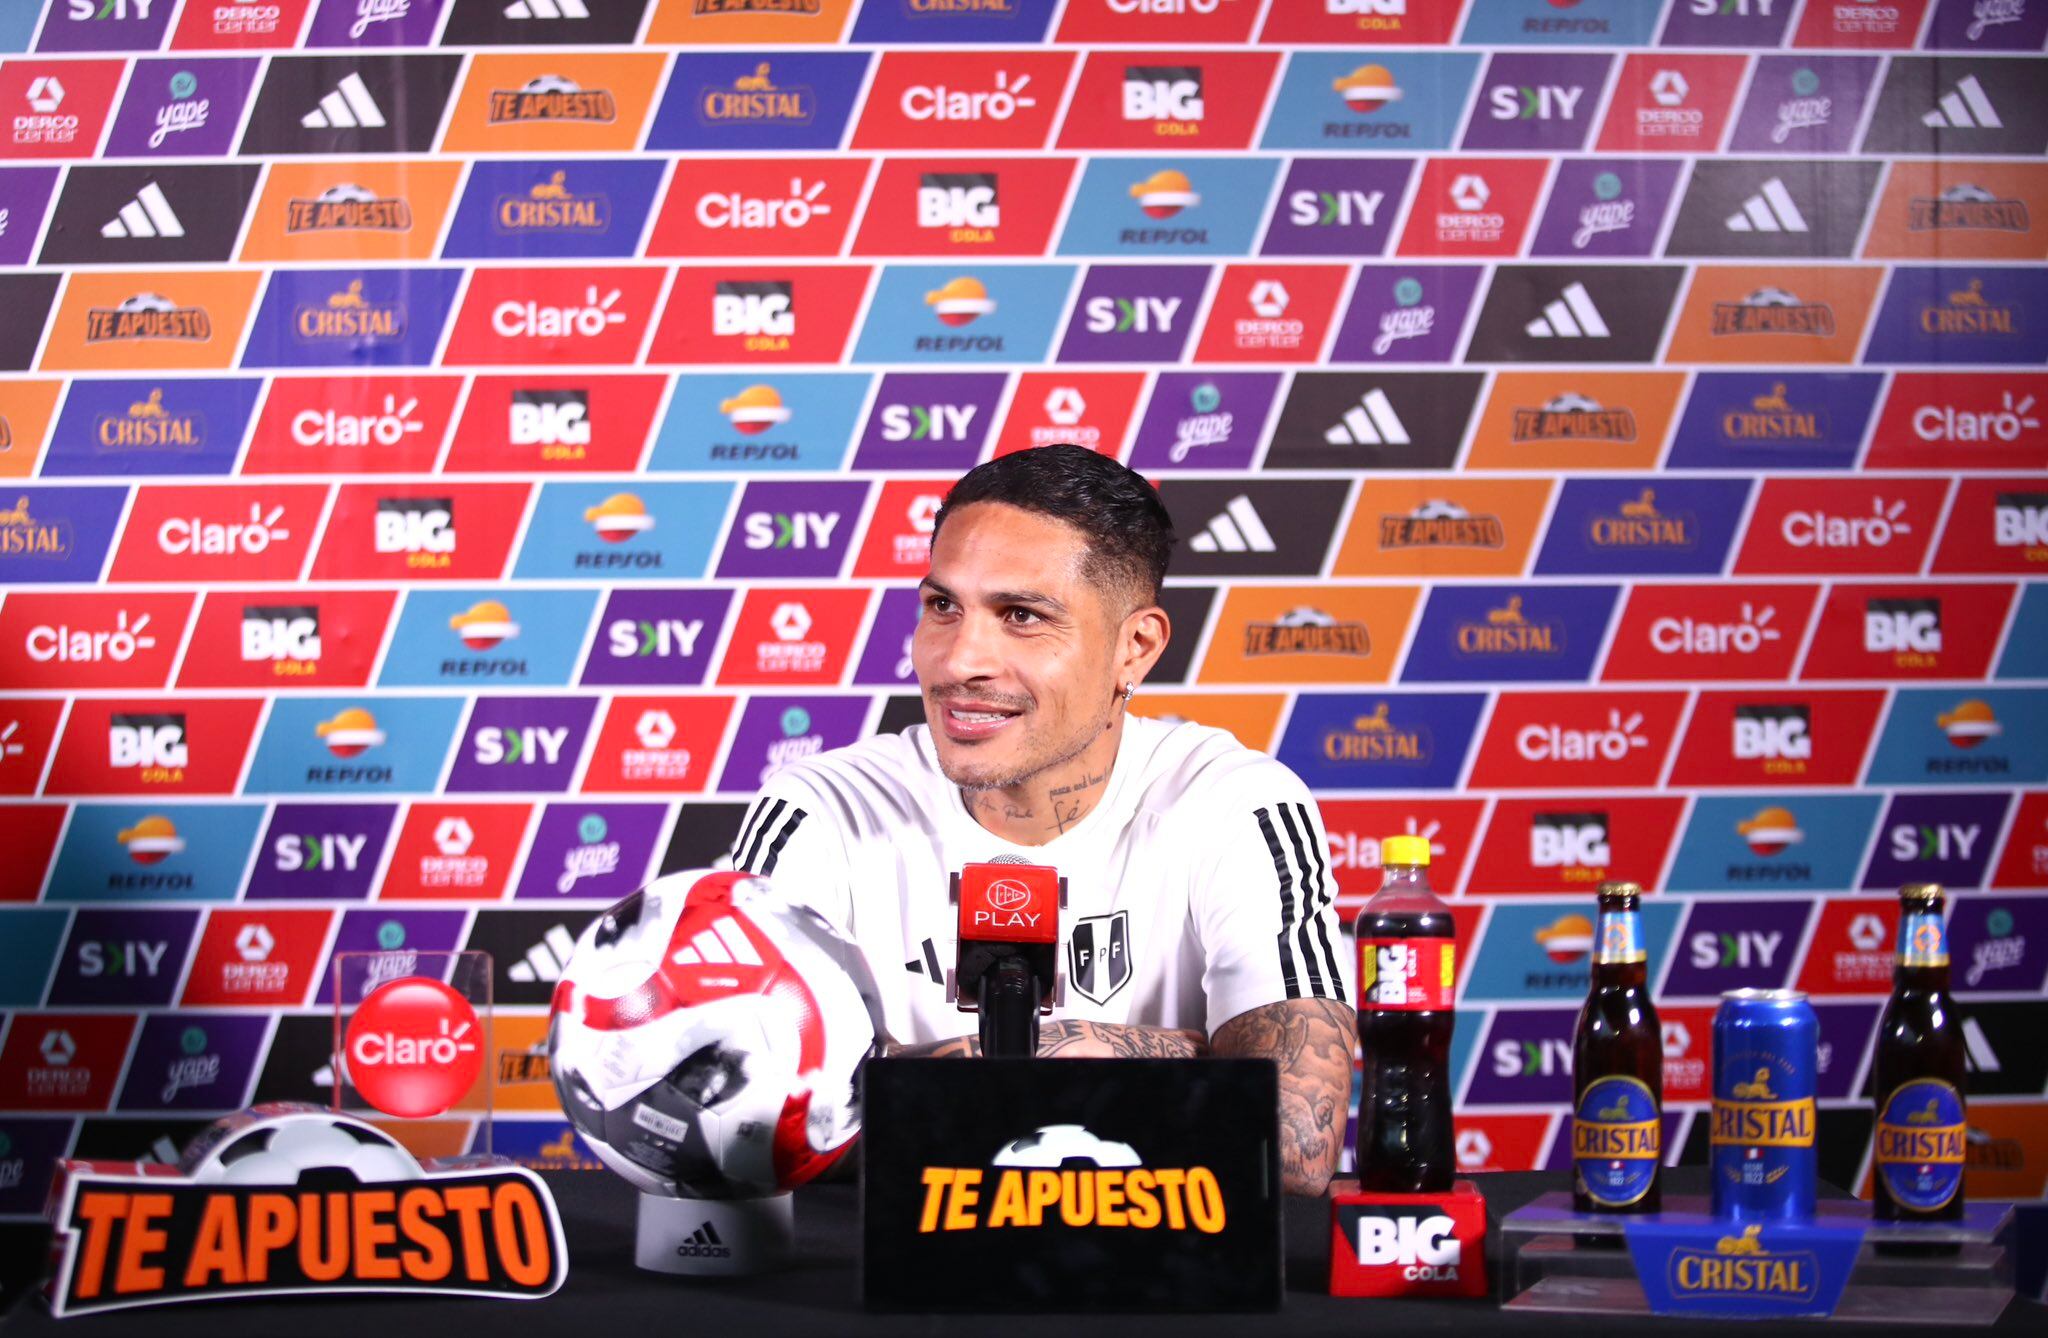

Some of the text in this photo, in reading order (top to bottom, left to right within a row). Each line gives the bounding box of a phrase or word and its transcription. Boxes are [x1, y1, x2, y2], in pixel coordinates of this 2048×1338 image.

[213, 6, 280, 20] DERCO
[1357, 19, 1401, 30] COLA
[1522, 18, 1611, 33] REPSOL
[1833, 7, 1898, 20] DERCO
[491, 91, 611, 121] TE APUESTO
[706, 93, 806, 118] CRISTAL
[900, 85, 1016, 120] Claro
[1123, 82, 1203, 119] BIG
[14, 116, 78, 129] DERCO
[148, 97, 210, 149] yape
[1155, 122, 1198, 136] COLA
[1637, 109, 1702, 122] DERCO
[1771, 96, 1833, 144] yape
[1324, 123, 1410, 138] REPSOL
[288, 200, 409, 231] TE APUESTO
[501, 202, 602, 225] CRISTAL
[695, 191, 812, 228] Claro
[917, 188, 999, 227] BIG
[1437, 214, 1504, 228] DERCO
[950, 230, 994, 242] COLA
[1120, 229, 1209, 244] REPSOL
[1571, 200, 1636, 249] yape
[88, 311, 207, 340] TE APUESTO
[299, 311, 398, 335] CRISTAL
[492, 301, 607, 336] Claro
[713, 295, 794, 335] BIG
[1237, 321, 1303, 334] DERCO
[1713, 305, 1832, 335] TE APUESTO
[1922, 307, 2016, 334] CRISTAL
[745, 337, 789, 351] COLA
[914, 336, 1004, 352] REPSOL
[1372, 306, 1435, 355] yape
[100, 420, 198, 444] CRISTAL
[292, 408, 408, 445] Claro
[510, 400, 591, 444] BIG
[1169, 410, 1233, 461] yape
[1515, 411, 1632, 441] TE APUESTO
[1723, 413, 1823, 439] CRISTAL
[1913, 403, 2021, 442] Claro
[541, 446, 585, 458] COLA
[711, 444, 801, 461] REPSOL
[0, 526, 66, 554] ISTAL
[158, 515, 271, 555] Claro
[375, 511, 455, 552] BIG
[1381, 517, 1501, 547] TE APUESTO
[1592, 519, 1690, 545] CRISTAL
[1782, 510, 1892, 548] Claro
[407, 554, 450, 566] COLA
[575, 552, 663, 569] REPSOL
[25, 622, 138, 662] Claro
[242, 619, 320, 660] BIG
[1249, 626, 1369, 655] TE APUESTO
[1459, 627, 1558, 652] CRISTAL
[1649, 616, 1762, 654] Claro
[1865, 612, 1941, 651] BIG
[273, 661, 316, 674] COLA
[441, 660, 529, 676] REPSOL
[109, 727, 187, 767] BIG
[1324, 732, 1424, 760] CRISTAL
[1515, 722, 1630, 761] Claro
[1732, 719, 1811, 758] BIG
[141, 768, 183, 782] COLA
[307, 767, 393, 783] REPSOL
[1531, 826, 1609, 865] BIG
[557, 843, 621, 893] yape
[975, 911, 1041, 927] PLAY
[361, 947, 418, 999] yape
[1377, 944, 1407, 1004] BIG
[354, 1030, 460, 1065] Claro
[163, 1055, 221, 1104] yape
[1576, 1125, 1659, 1153] CRISTAL
[1880, 1129, 1965, 1158] CRISTAL
[919, 1165, 1226, 1234] TE APUESTO
[75, 1181, 552, 1298] TE APUESTO
[677, 1244, 731, 1258] adidas
[1358, 1215, 1461, 1266] BIG
[1403, 1265, 1459, 1281] COLA
[1677, 1256, 1808, 1292] CRISTAL
